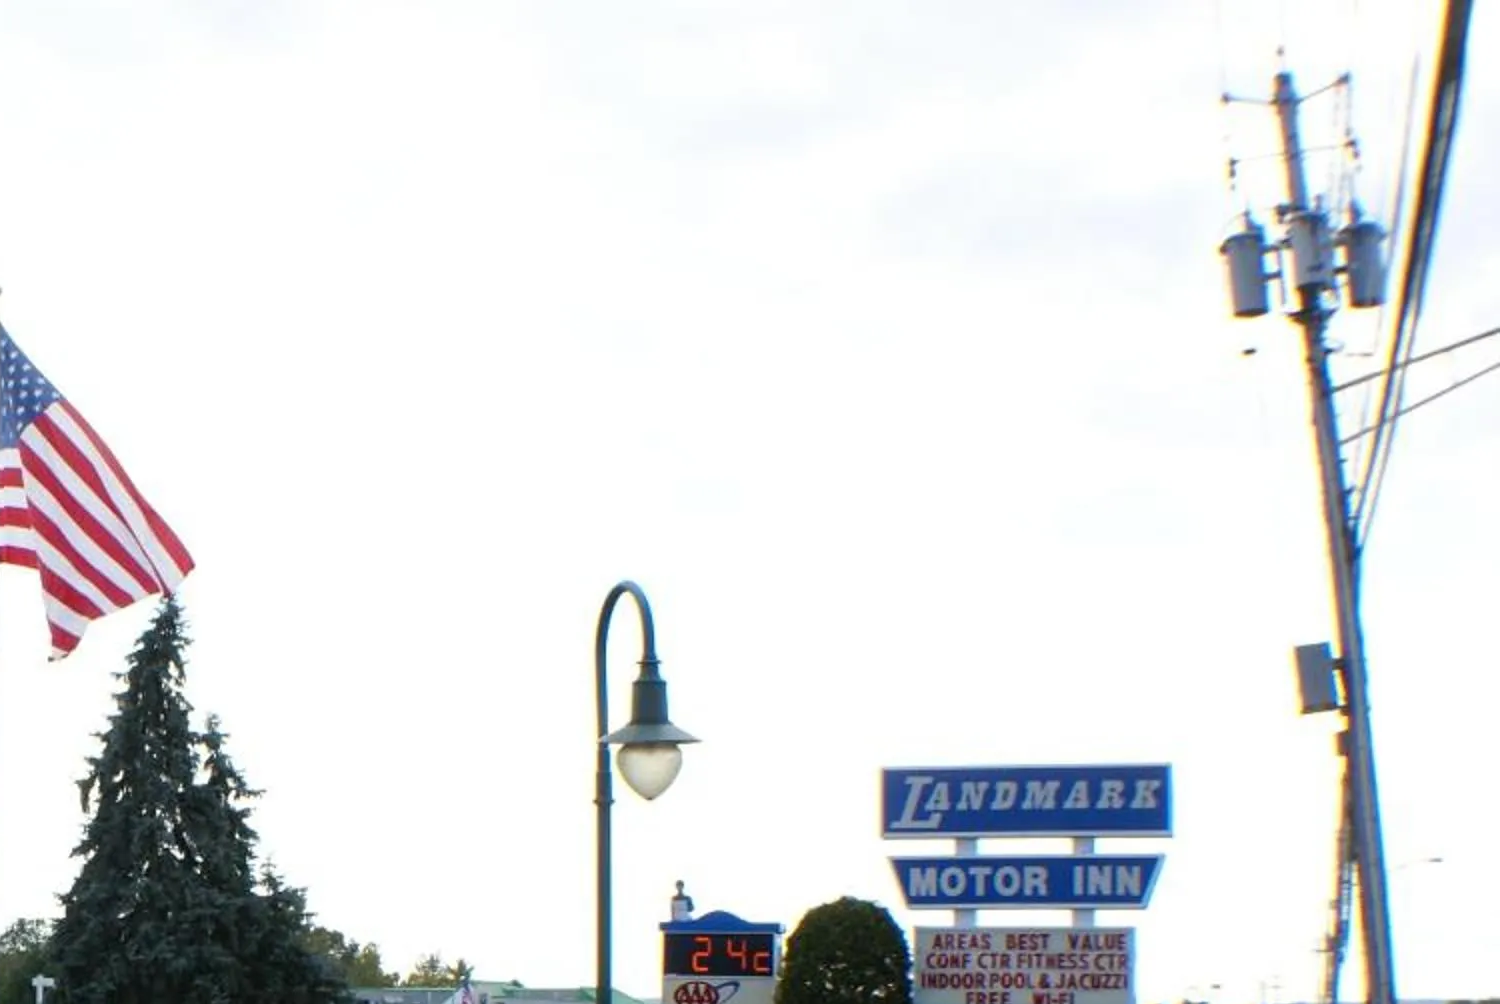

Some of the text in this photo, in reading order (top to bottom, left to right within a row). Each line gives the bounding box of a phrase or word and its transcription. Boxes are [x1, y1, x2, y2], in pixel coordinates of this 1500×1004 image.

[890, 776, 1162, 829] LANDMARK
[909, 865, 1141, 897] MOTOR INN
[932, 933, 1126, 951] AREAS BEST VALUE
[926, 953, 1128, 970] CONF CTR FITNESS CTR
[921, 974, 1129, 990] INDOOR POOL & JACUZZI
